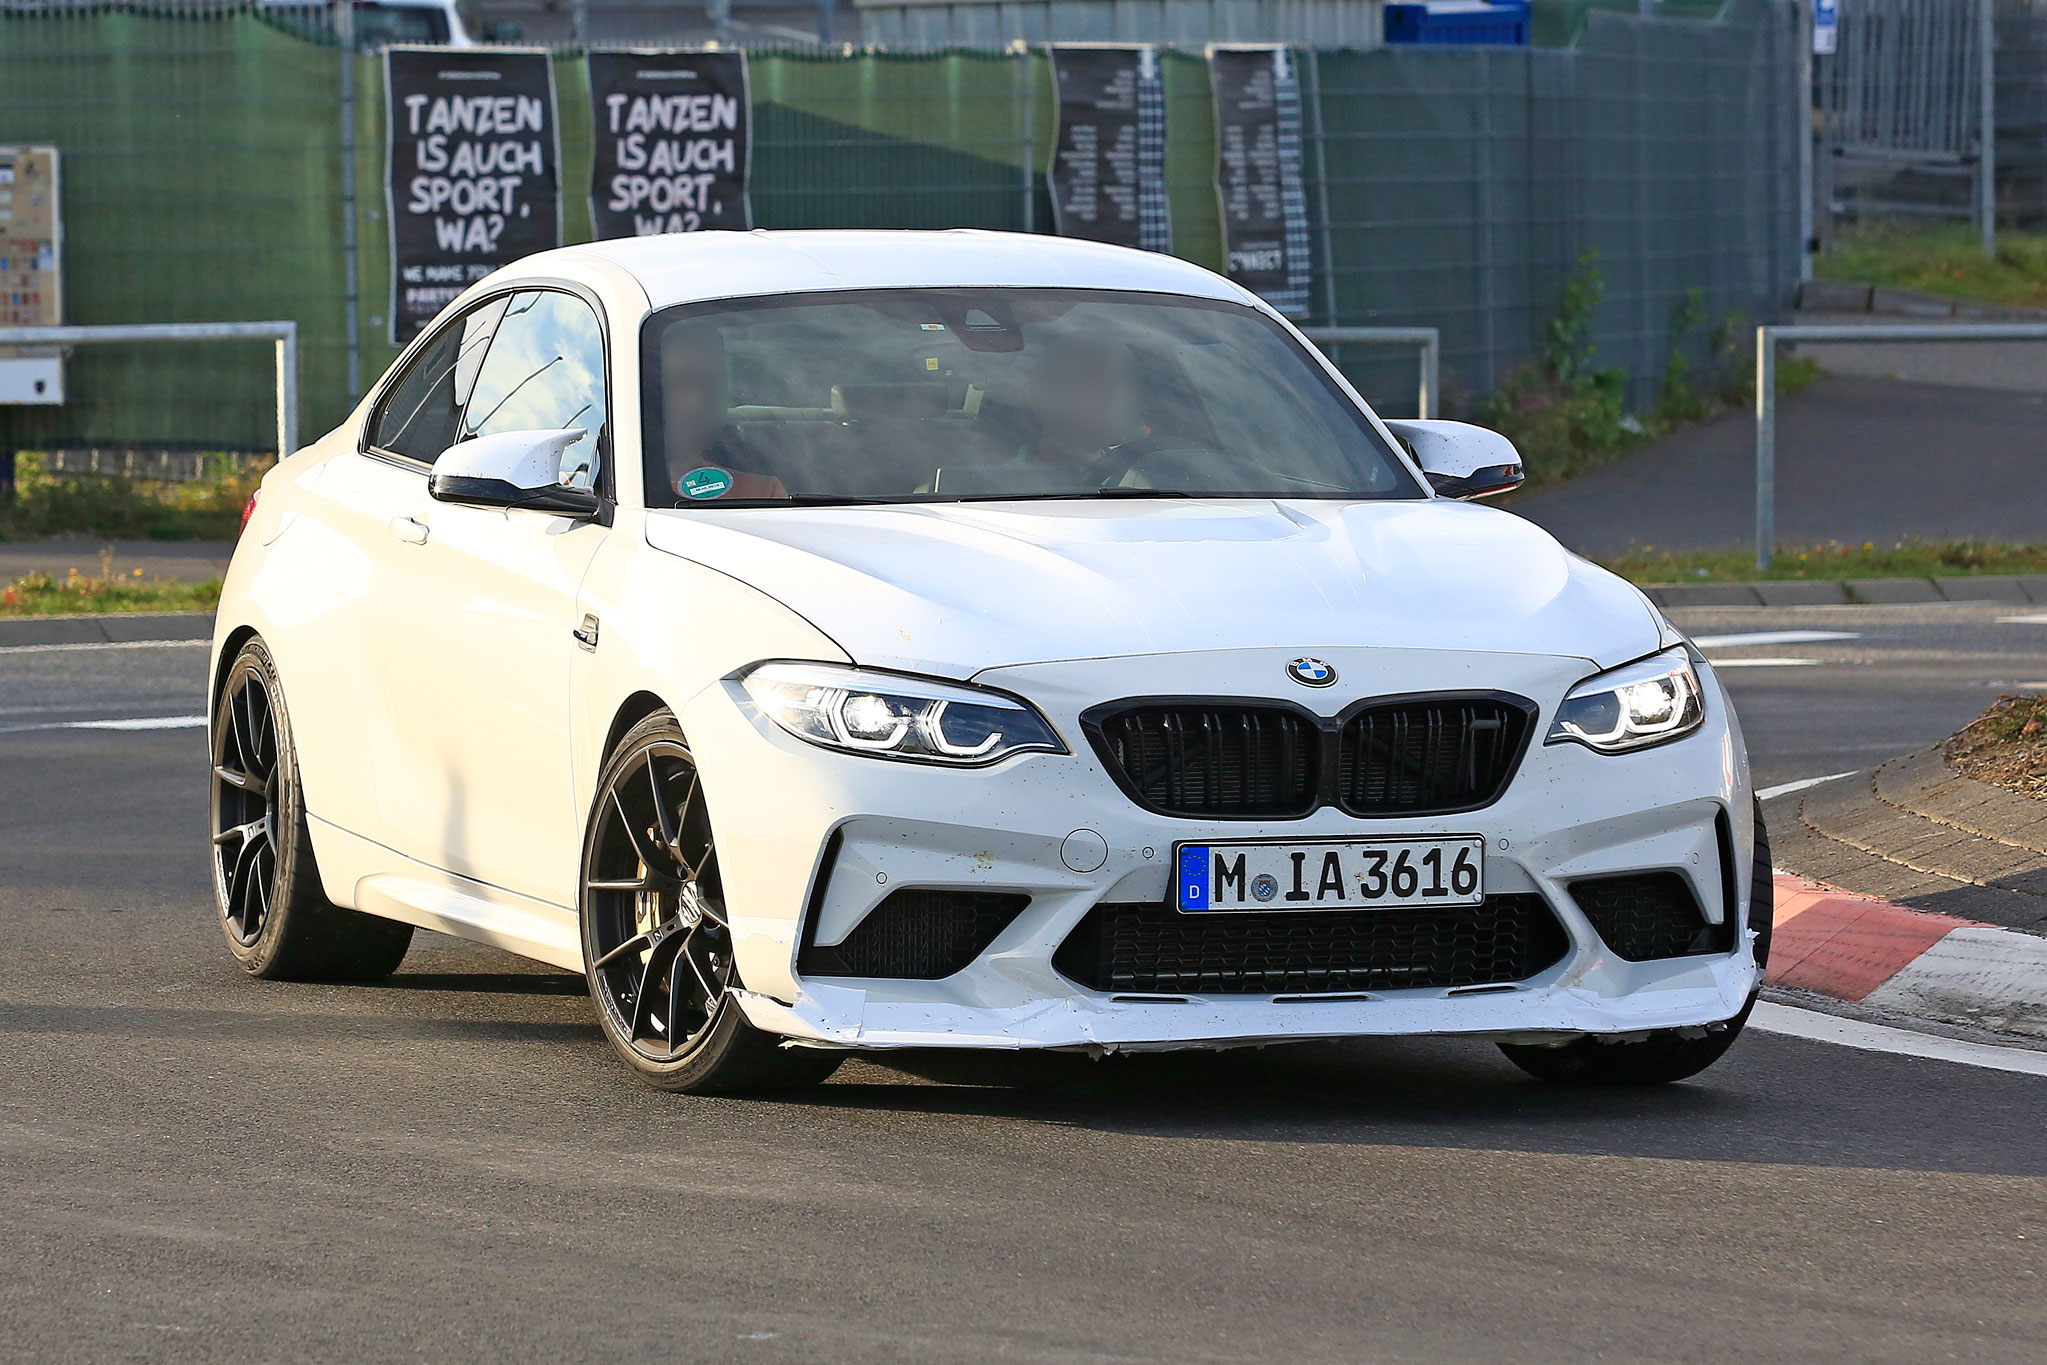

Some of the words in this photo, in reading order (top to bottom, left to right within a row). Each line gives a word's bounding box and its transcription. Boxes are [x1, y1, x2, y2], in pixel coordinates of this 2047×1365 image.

[404, 94, 543, 135] TANZEN
[606, 93, 738, 134] TANZEN
[416, 133, 449, 172] IS
[450, 139, 544, 178] AUCH
[616, 132, 648, 171] IS
[648, 137, 735, 175] AUCH
[435, 214, 506, 254] WA?
[1188, 884, 1201, 899] D
[1214, 852, 1246, 903] M
[1285, 851, 1346, 901] IA
[1360, 846, 1479, 899] 3616
